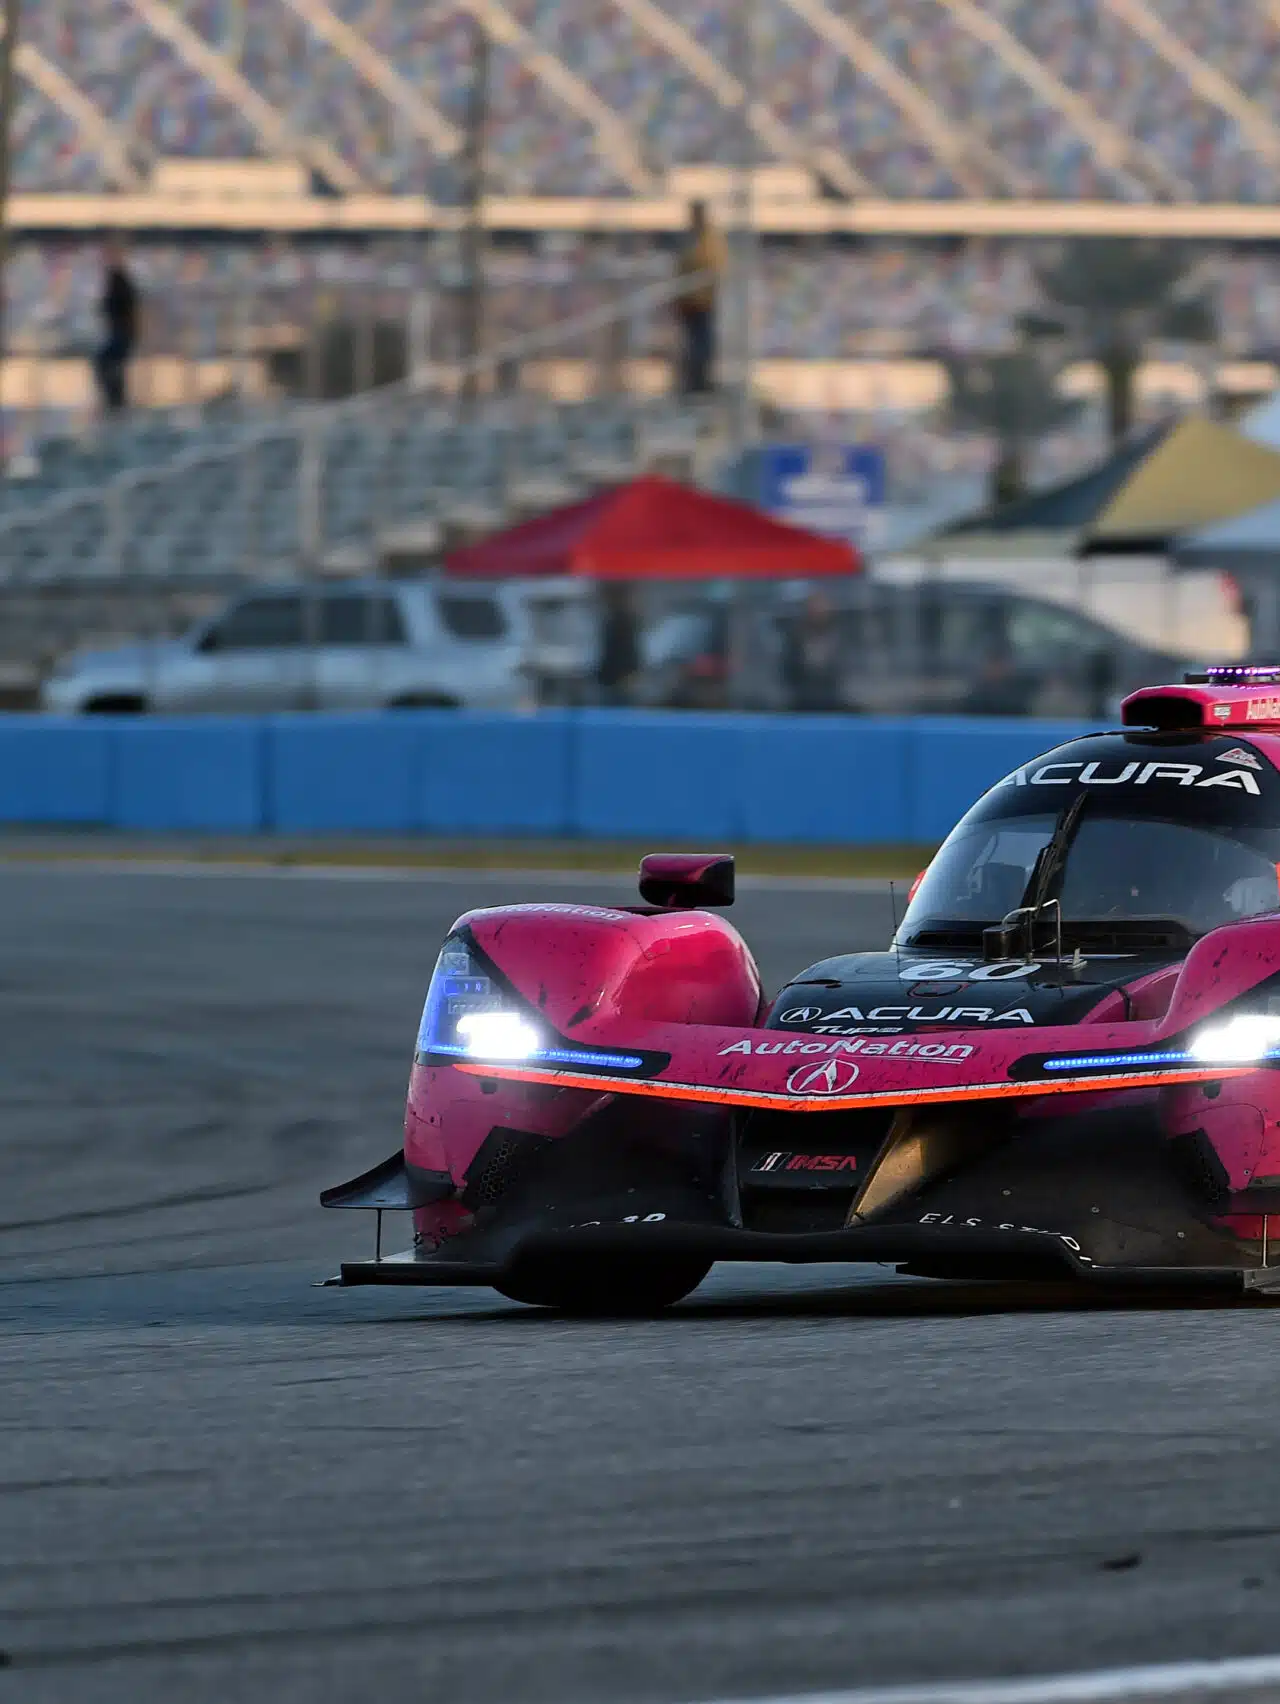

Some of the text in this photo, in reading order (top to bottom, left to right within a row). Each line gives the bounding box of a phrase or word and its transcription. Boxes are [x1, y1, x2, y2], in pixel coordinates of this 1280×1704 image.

[899, 961, 1041, 981] 60
[820, 1007, 1035, 1024] ACURA
[811, 1026, 903, 1036] Type
[717, 1036, 975, 1058] AutoNation
[784, 1155, 857, 1171] IMSA
